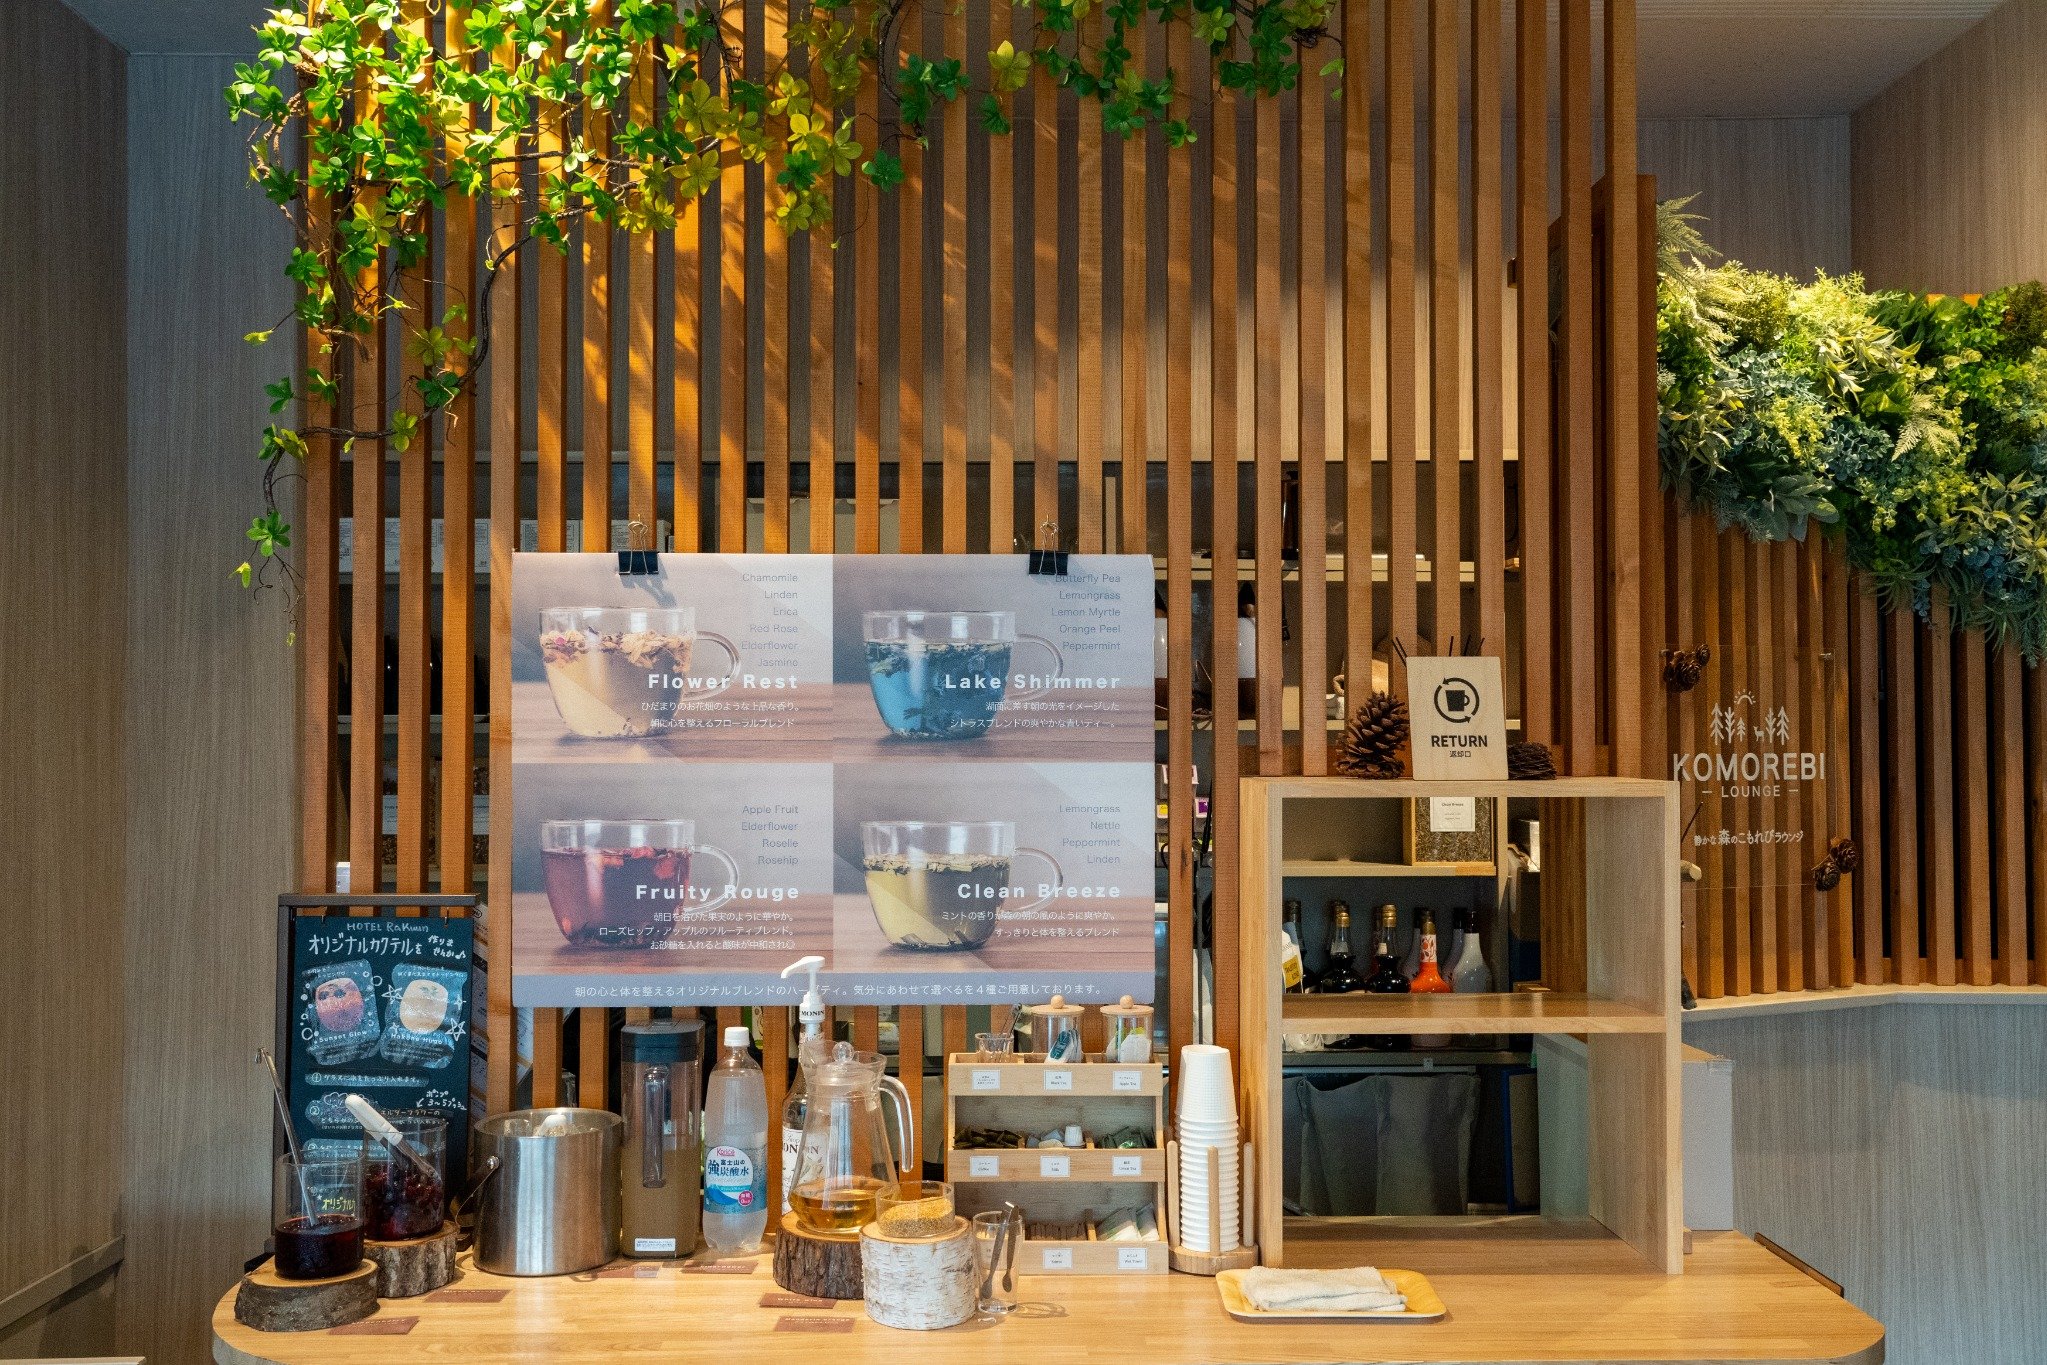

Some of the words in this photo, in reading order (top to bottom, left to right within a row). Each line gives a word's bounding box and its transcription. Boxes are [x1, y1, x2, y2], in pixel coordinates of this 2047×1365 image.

[742, 573, 798, 582] Chamomile
[1055, 573, 1099, 584] Butterfly
[1102, 574, 1121, 583] Pea
[764, 590, 798, 599] Linden
[1059, 590, 1121, 601] Lemongrass
[773, 607, 798, 616] Erica
[1051, 607, 1086, 617] Lemon
[1088, 607, 1121, 618] Myrtle
[750, 624, 770, 633] Red
[774, 624, 798, 633] Rose
[1059, 624, 1096, 635] Orange
[1099, 624, 1121, 633] Peel
[741, 641, 798, 650] Elderflower
[1063, 641, 1121, 652] Peppermint
[758, 657, 798, 667] Jasmine
[648, 674, 731, 689] Flower
[744, 674, 798, 689] Rest
[945, 674, 1001, 689] Lake
[1014, 674, 1120, 689] Shimmer
[1431, 734, 1488, 748] RETURN
[1673, 752, 1825, 782] KOMOREBI
[1721, 785, 1781, 798] LOUNGE
[742, 804, 772, 816] Apple
[775, 804, 798, 814] Fruit
[1059, 804, 1121, 815] Lemongrass
[741, 821, 798, 831] Elderflower
[1090, 821, 1121, 830] Nettle
[762, 838, 798, 848] Roselle
[1062, 838, 1121, 849] Peppermint
[758, 855, 799, 866] Rosehip
[1087, 854, 1121, 864] Linden
[636, 885, 712, 902] Fruity
[724, 885, 799, 902] Rouge
[958, 883, 1026, 898] Clean
[1038, 883, 1120, 898] Breeze
[346, 922, 382, 931] HOTEL
[308, 932, 423, 956] オリジナルカクテルを
[801, 1010, 825, 1018] MONIN
